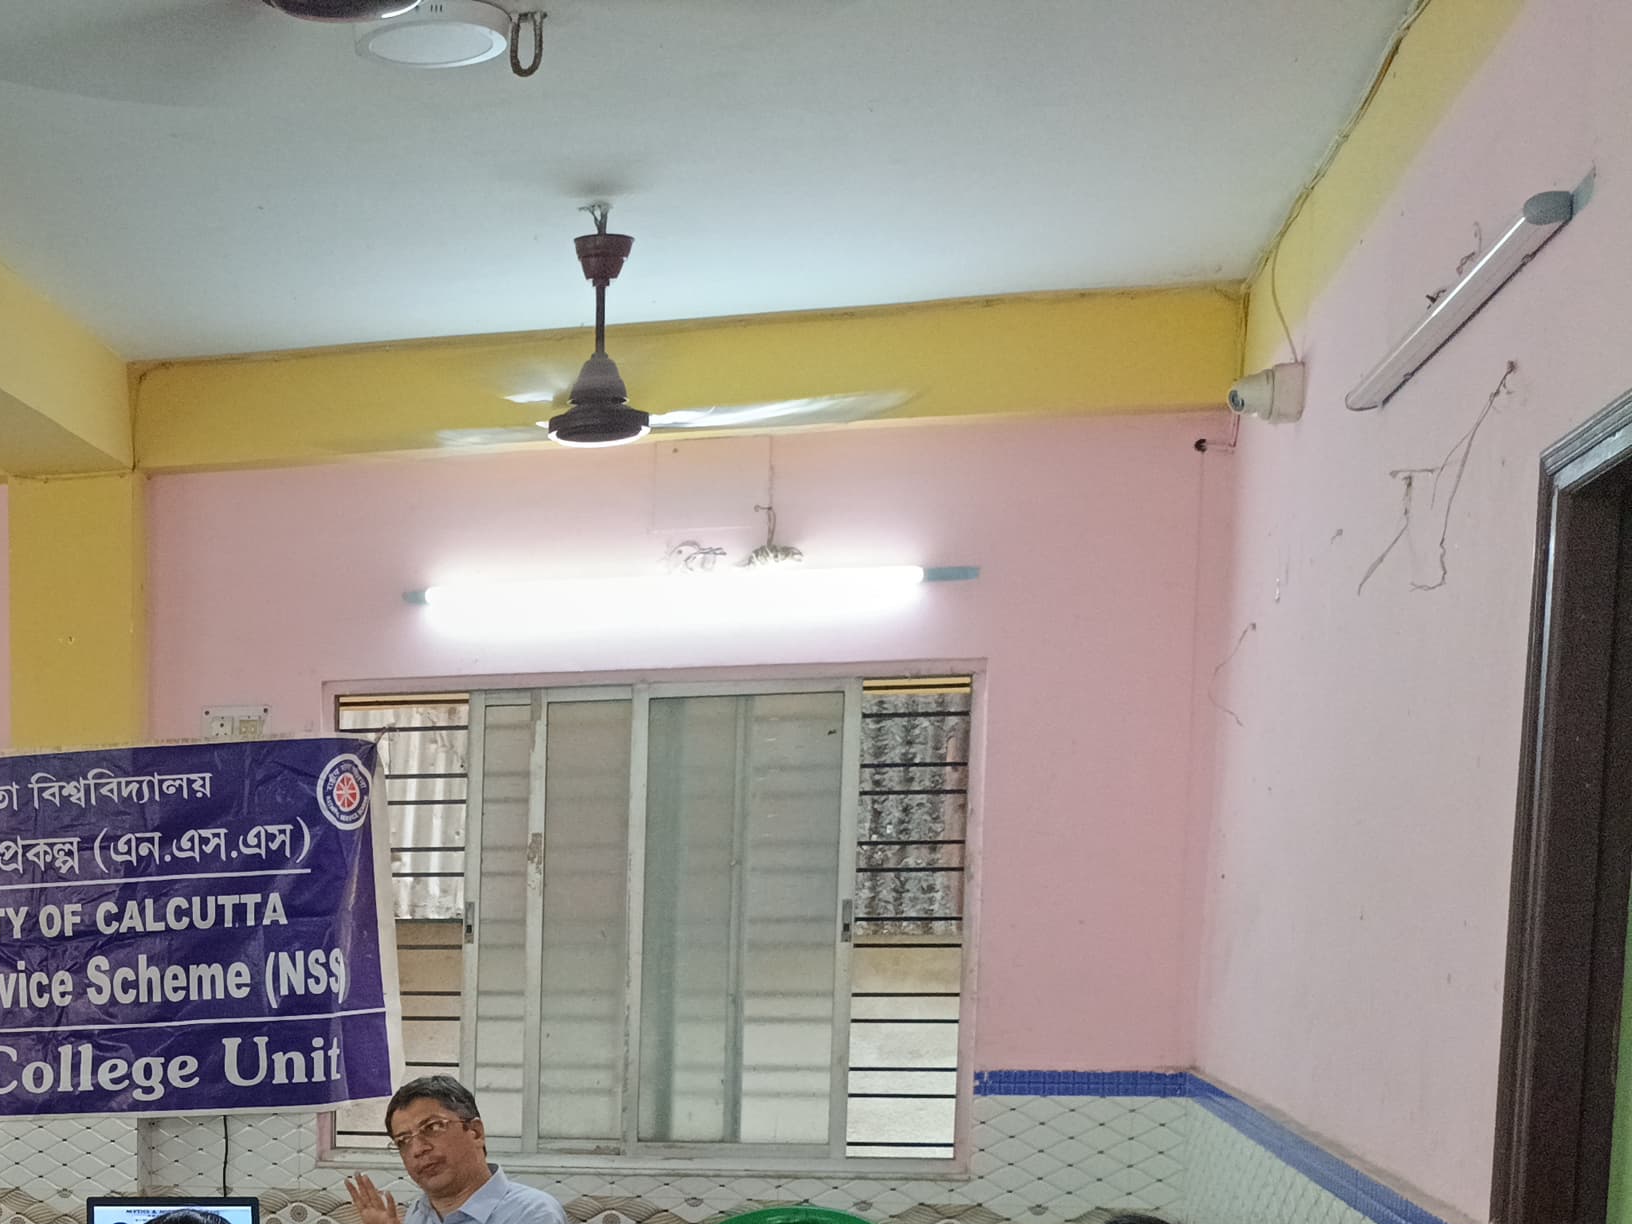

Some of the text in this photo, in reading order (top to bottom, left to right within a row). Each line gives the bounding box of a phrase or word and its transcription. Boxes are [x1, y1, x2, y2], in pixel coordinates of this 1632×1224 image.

[28, 768, 213, 809] বিশ্ববিদ্যালয়
[93, 816, 312, 874] (এন.এস.এস)
[38, 903, 83, 938] OF
[95, 892, 289, 935] CALCUTTA
[86, 954, 252, 1005] Scheme
[221, 1035, 342, 1088] Unit
